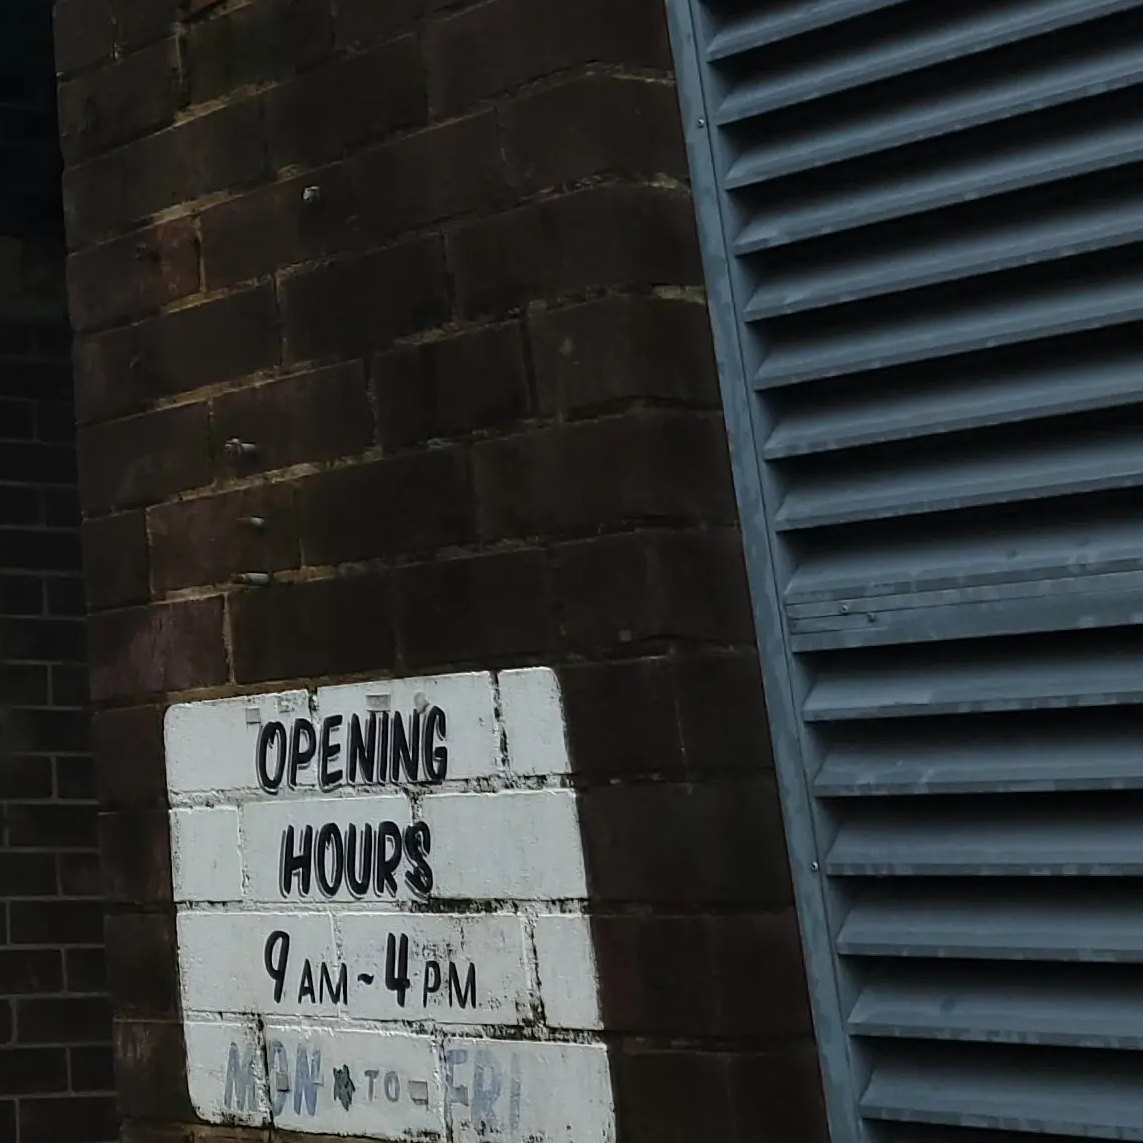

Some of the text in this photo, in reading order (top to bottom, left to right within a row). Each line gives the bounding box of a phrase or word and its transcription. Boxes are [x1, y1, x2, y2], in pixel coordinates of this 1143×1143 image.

[257, 706, 449, 794] OPENING
[278, 821, 435, 900] HOURS
[223, 1040, 321, 1117] MON
[364, 1070, 400, 1103] TO
